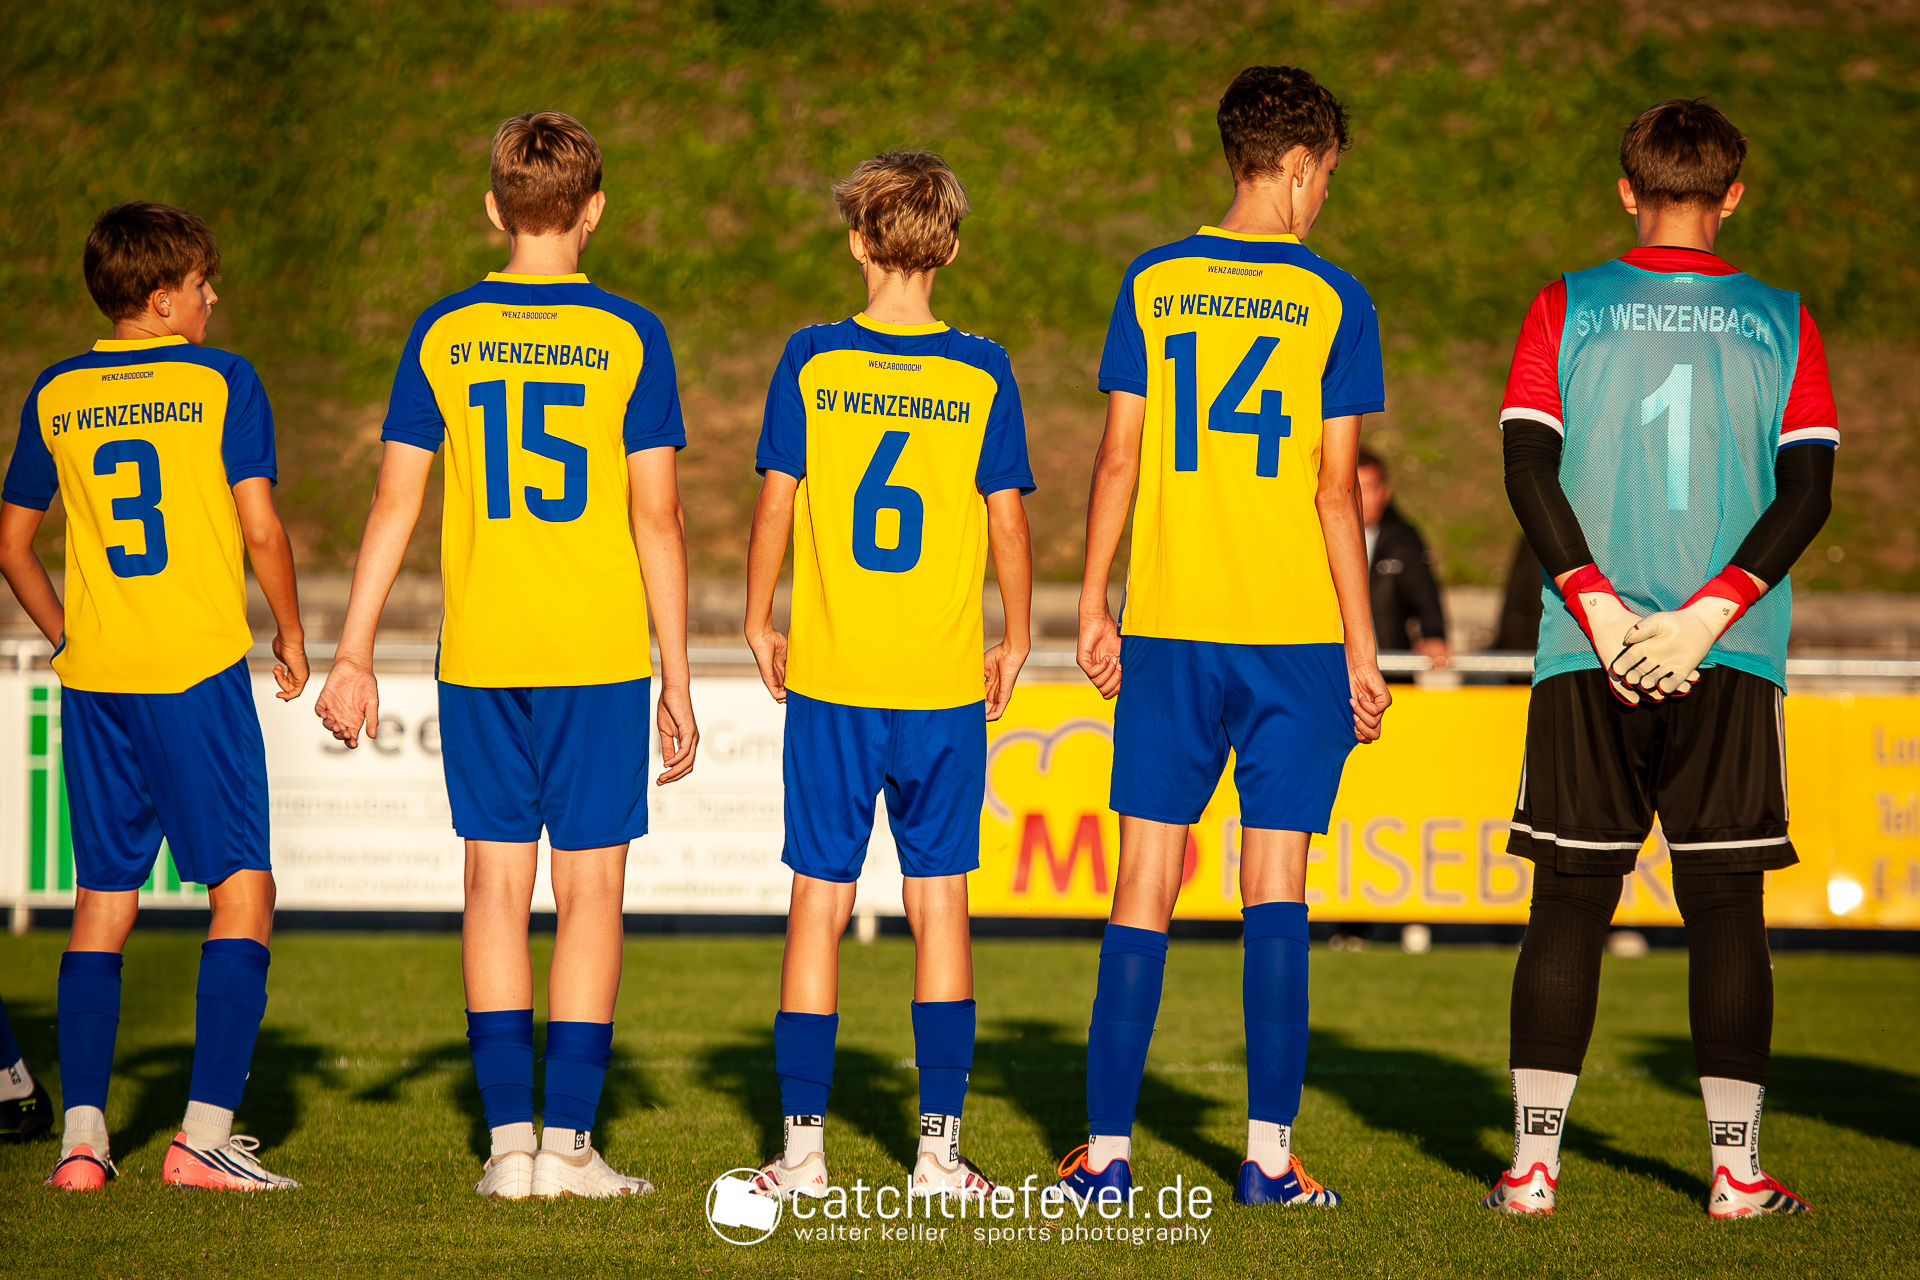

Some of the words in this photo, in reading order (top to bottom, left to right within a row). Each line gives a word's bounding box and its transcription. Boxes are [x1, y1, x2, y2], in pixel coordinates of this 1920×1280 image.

[1154, 294, 1174, 319] SV
[1180, 293, 1310, 327] WENZENBACH
[1576, 308, 1605, 337] SV
[450, 341, 471, 366] SV
[478, 340, 609, 371] WENZENBACH
[52, 411, 72, 437] SV
[76, 401, 203, 430] WENZENBACH
[816, 388, 838, 412] SV
[843, 390, 971, 424] WENZENBACH
[1164, 330, 1292, 478] 14
[468, 379, 588, 523] 15
[1640, 363, 1693, 511] 1
[92, 438, 169, 579] 3
[851, 430, 924, 574] 6
[920, 1114, 943, 1136] FS
[1527, 1108, 1561, 1133] FS
[1712, 1123, 1745, 1146] FS
[575, 1133, 585, 1149] FS
